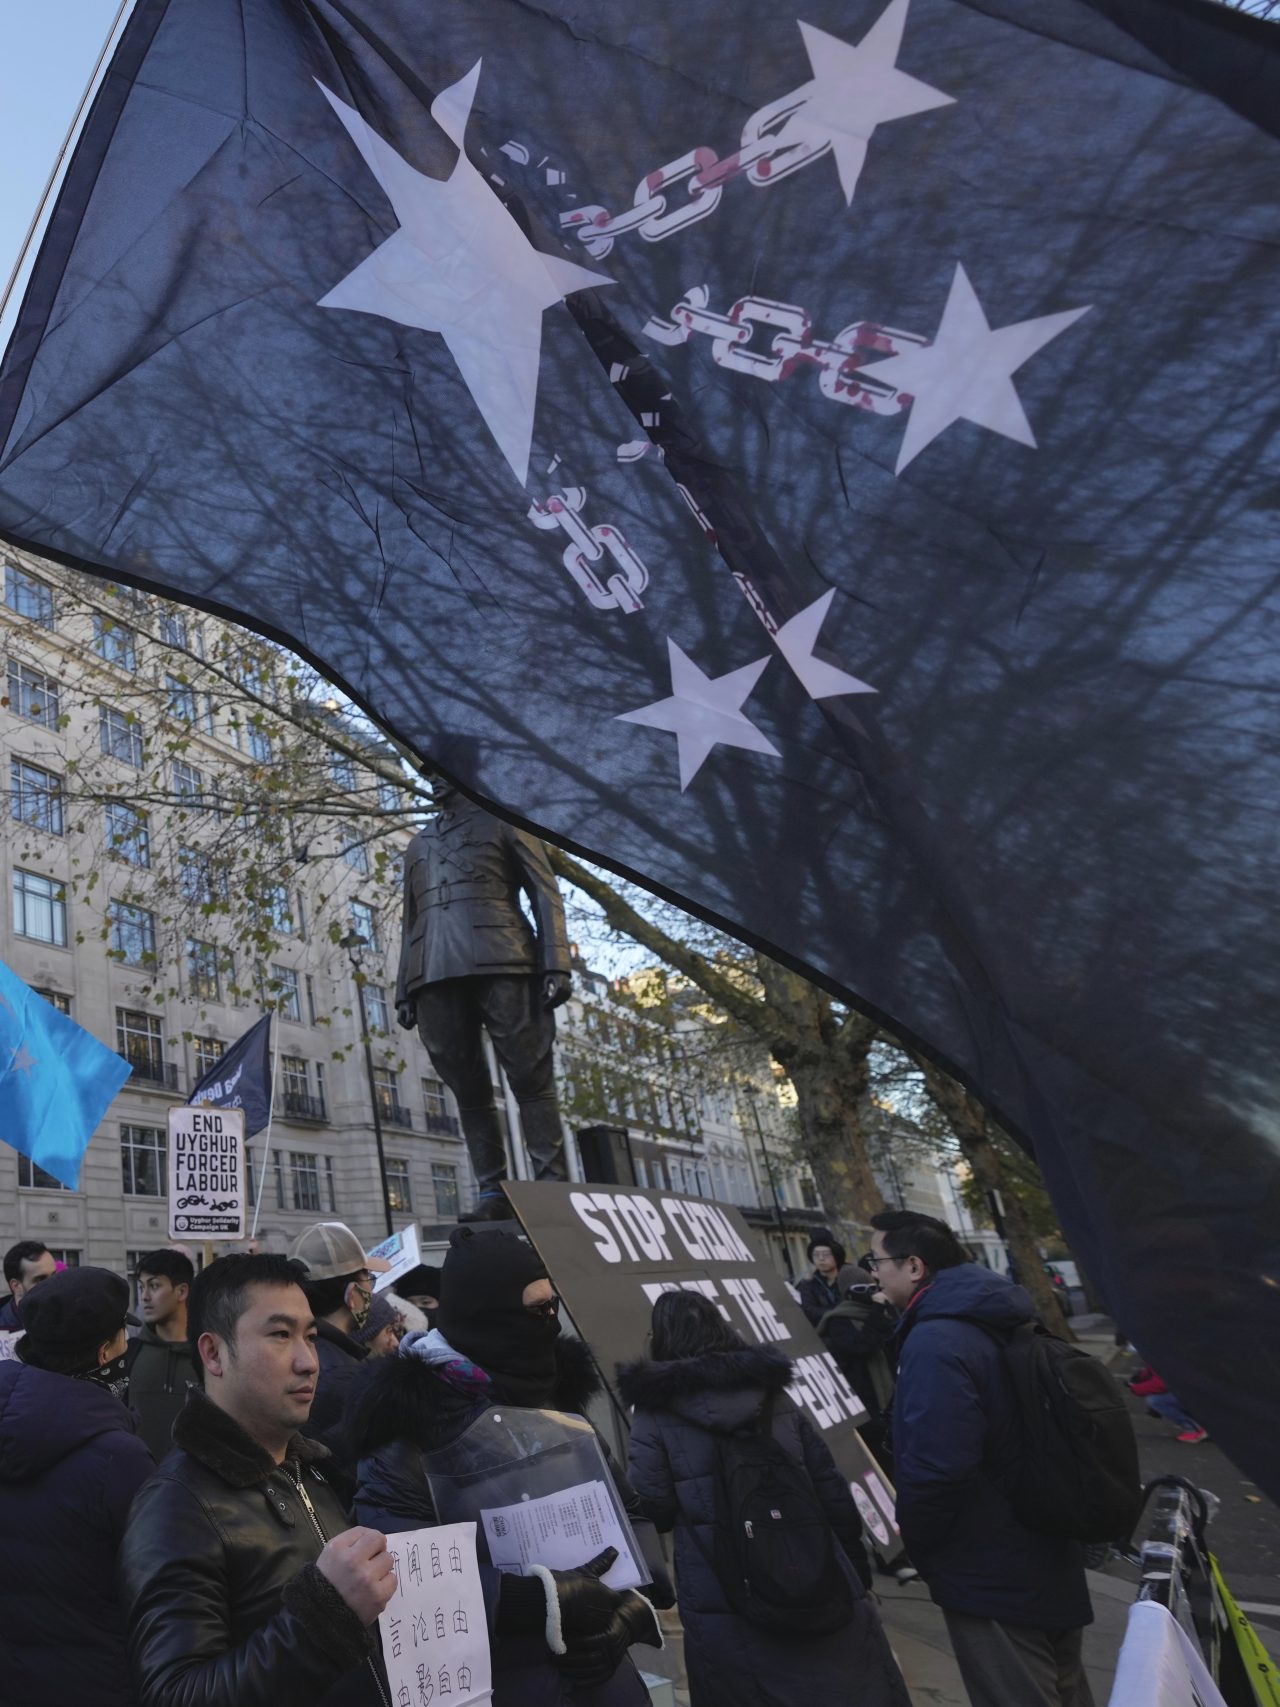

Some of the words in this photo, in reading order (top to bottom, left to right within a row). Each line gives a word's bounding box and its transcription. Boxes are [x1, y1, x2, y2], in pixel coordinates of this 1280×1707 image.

[193, 1115, 222, 1133] END
[176, 1133, 238, 1153] UYGHUR
[176, 1153, 237, 1173] FORCED
[176, 1173, 238, 1193] LABOUR
[569, 1192, 673, 1263] STOP
[661, 1198, 755, 1262] CHINA
[720, 1278, 792, 1343] THE
[389, 1600, 469, 1658] 言论自由
